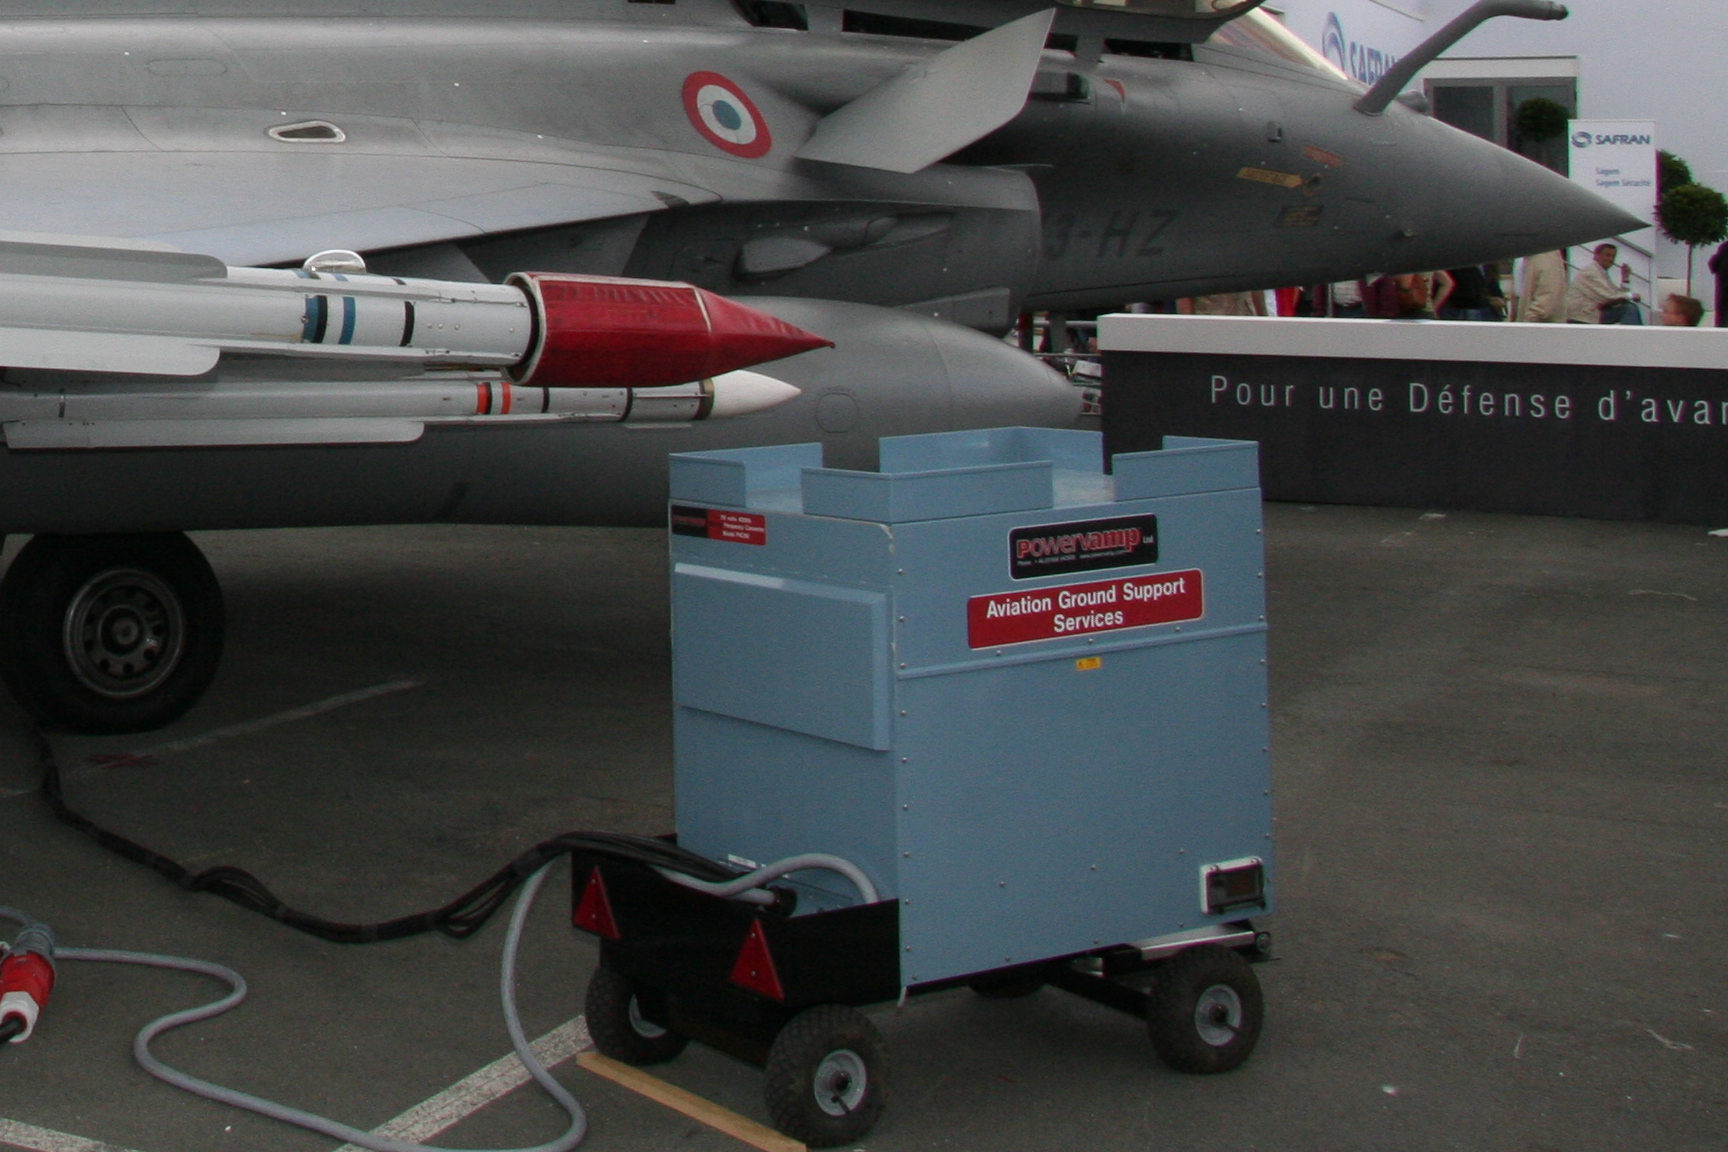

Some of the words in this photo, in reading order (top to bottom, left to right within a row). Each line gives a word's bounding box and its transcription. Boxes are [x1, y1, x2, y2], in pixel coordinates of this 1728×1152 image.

[1595, 134, 1650, 145] SAFRAN
[1211, 375, 1294, 406] Pour
[1319, 386, 1384, 411] une
[1409, 382, 1571, 419] Défense
[1142, 535, 1154, 544] Ltd
[986, 595, 1052, 618] Aviation
[1058, 586, 1116, 609] Ground
[1123, 577, 1185, 602] Support
[1053, 610, 1124, 633] Services
